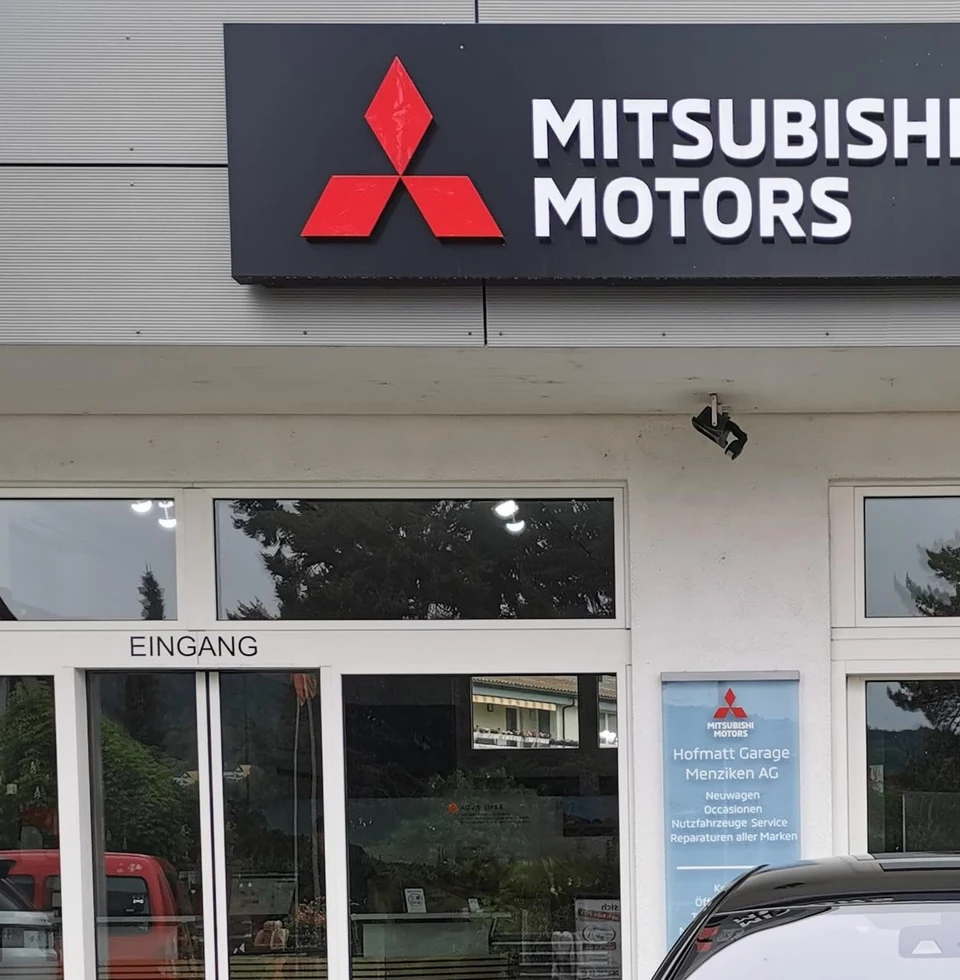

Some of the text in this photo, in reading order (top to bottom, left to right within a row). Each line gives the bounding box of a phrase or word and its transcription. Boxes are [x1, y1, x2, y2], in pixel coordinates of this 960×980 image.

[533, 176, 853, 243] MOTORS
[130, 636, 258, 657] EINGANG
[707, 721, 755, 730] MITSUBISHI
[713, 730, 748, 738] MOTORS
[673, 747, 790, 762] Hofmatt Garage
[685, 766, 779, 780] Menziken AG
[705, 791, 760, 802] Neuwagen
[704, 805, 763, 815] Occasionen
[671, 818, 788, 829] Nutzfahrzeuge Service
[670, 831, 798, 844] Reparaturen aller Marken
